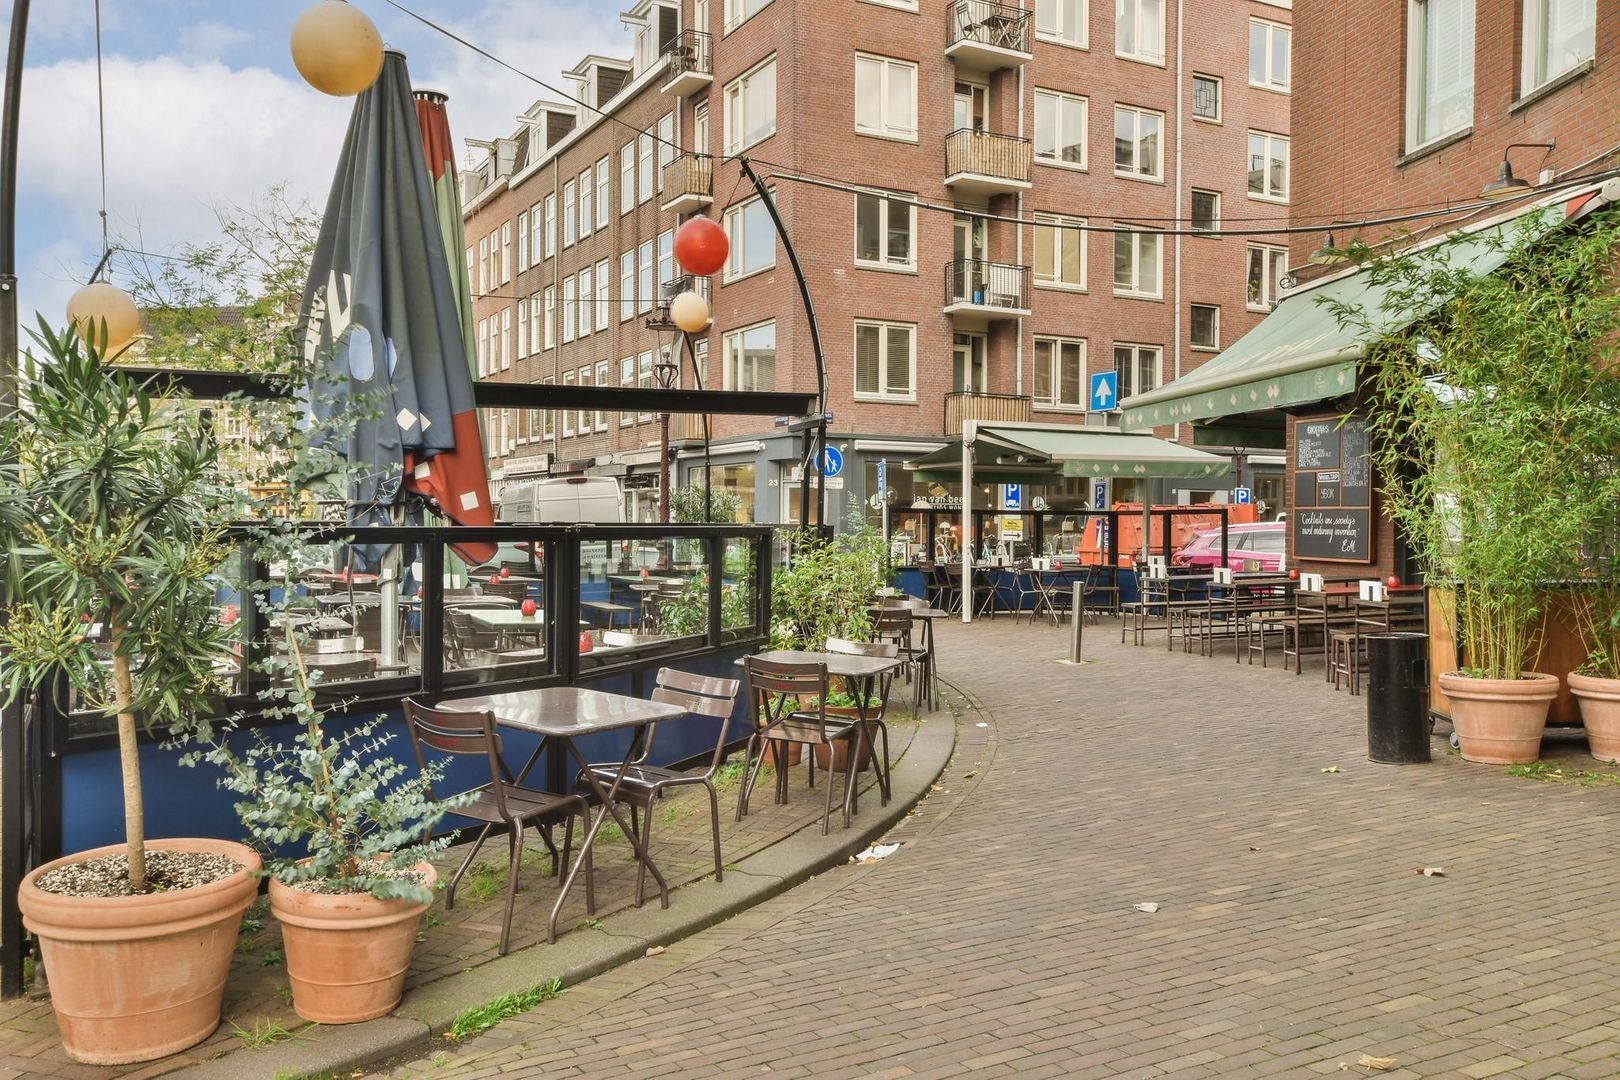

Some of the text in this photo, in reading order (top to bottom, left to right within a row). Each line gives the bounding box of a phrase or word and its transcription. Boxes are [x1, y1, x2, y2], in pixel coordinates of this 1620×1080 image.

[1008, 483, 1017, 497] P
[1096, 486, 1104, 500] P
[1238, 490, 1248, 503] P
